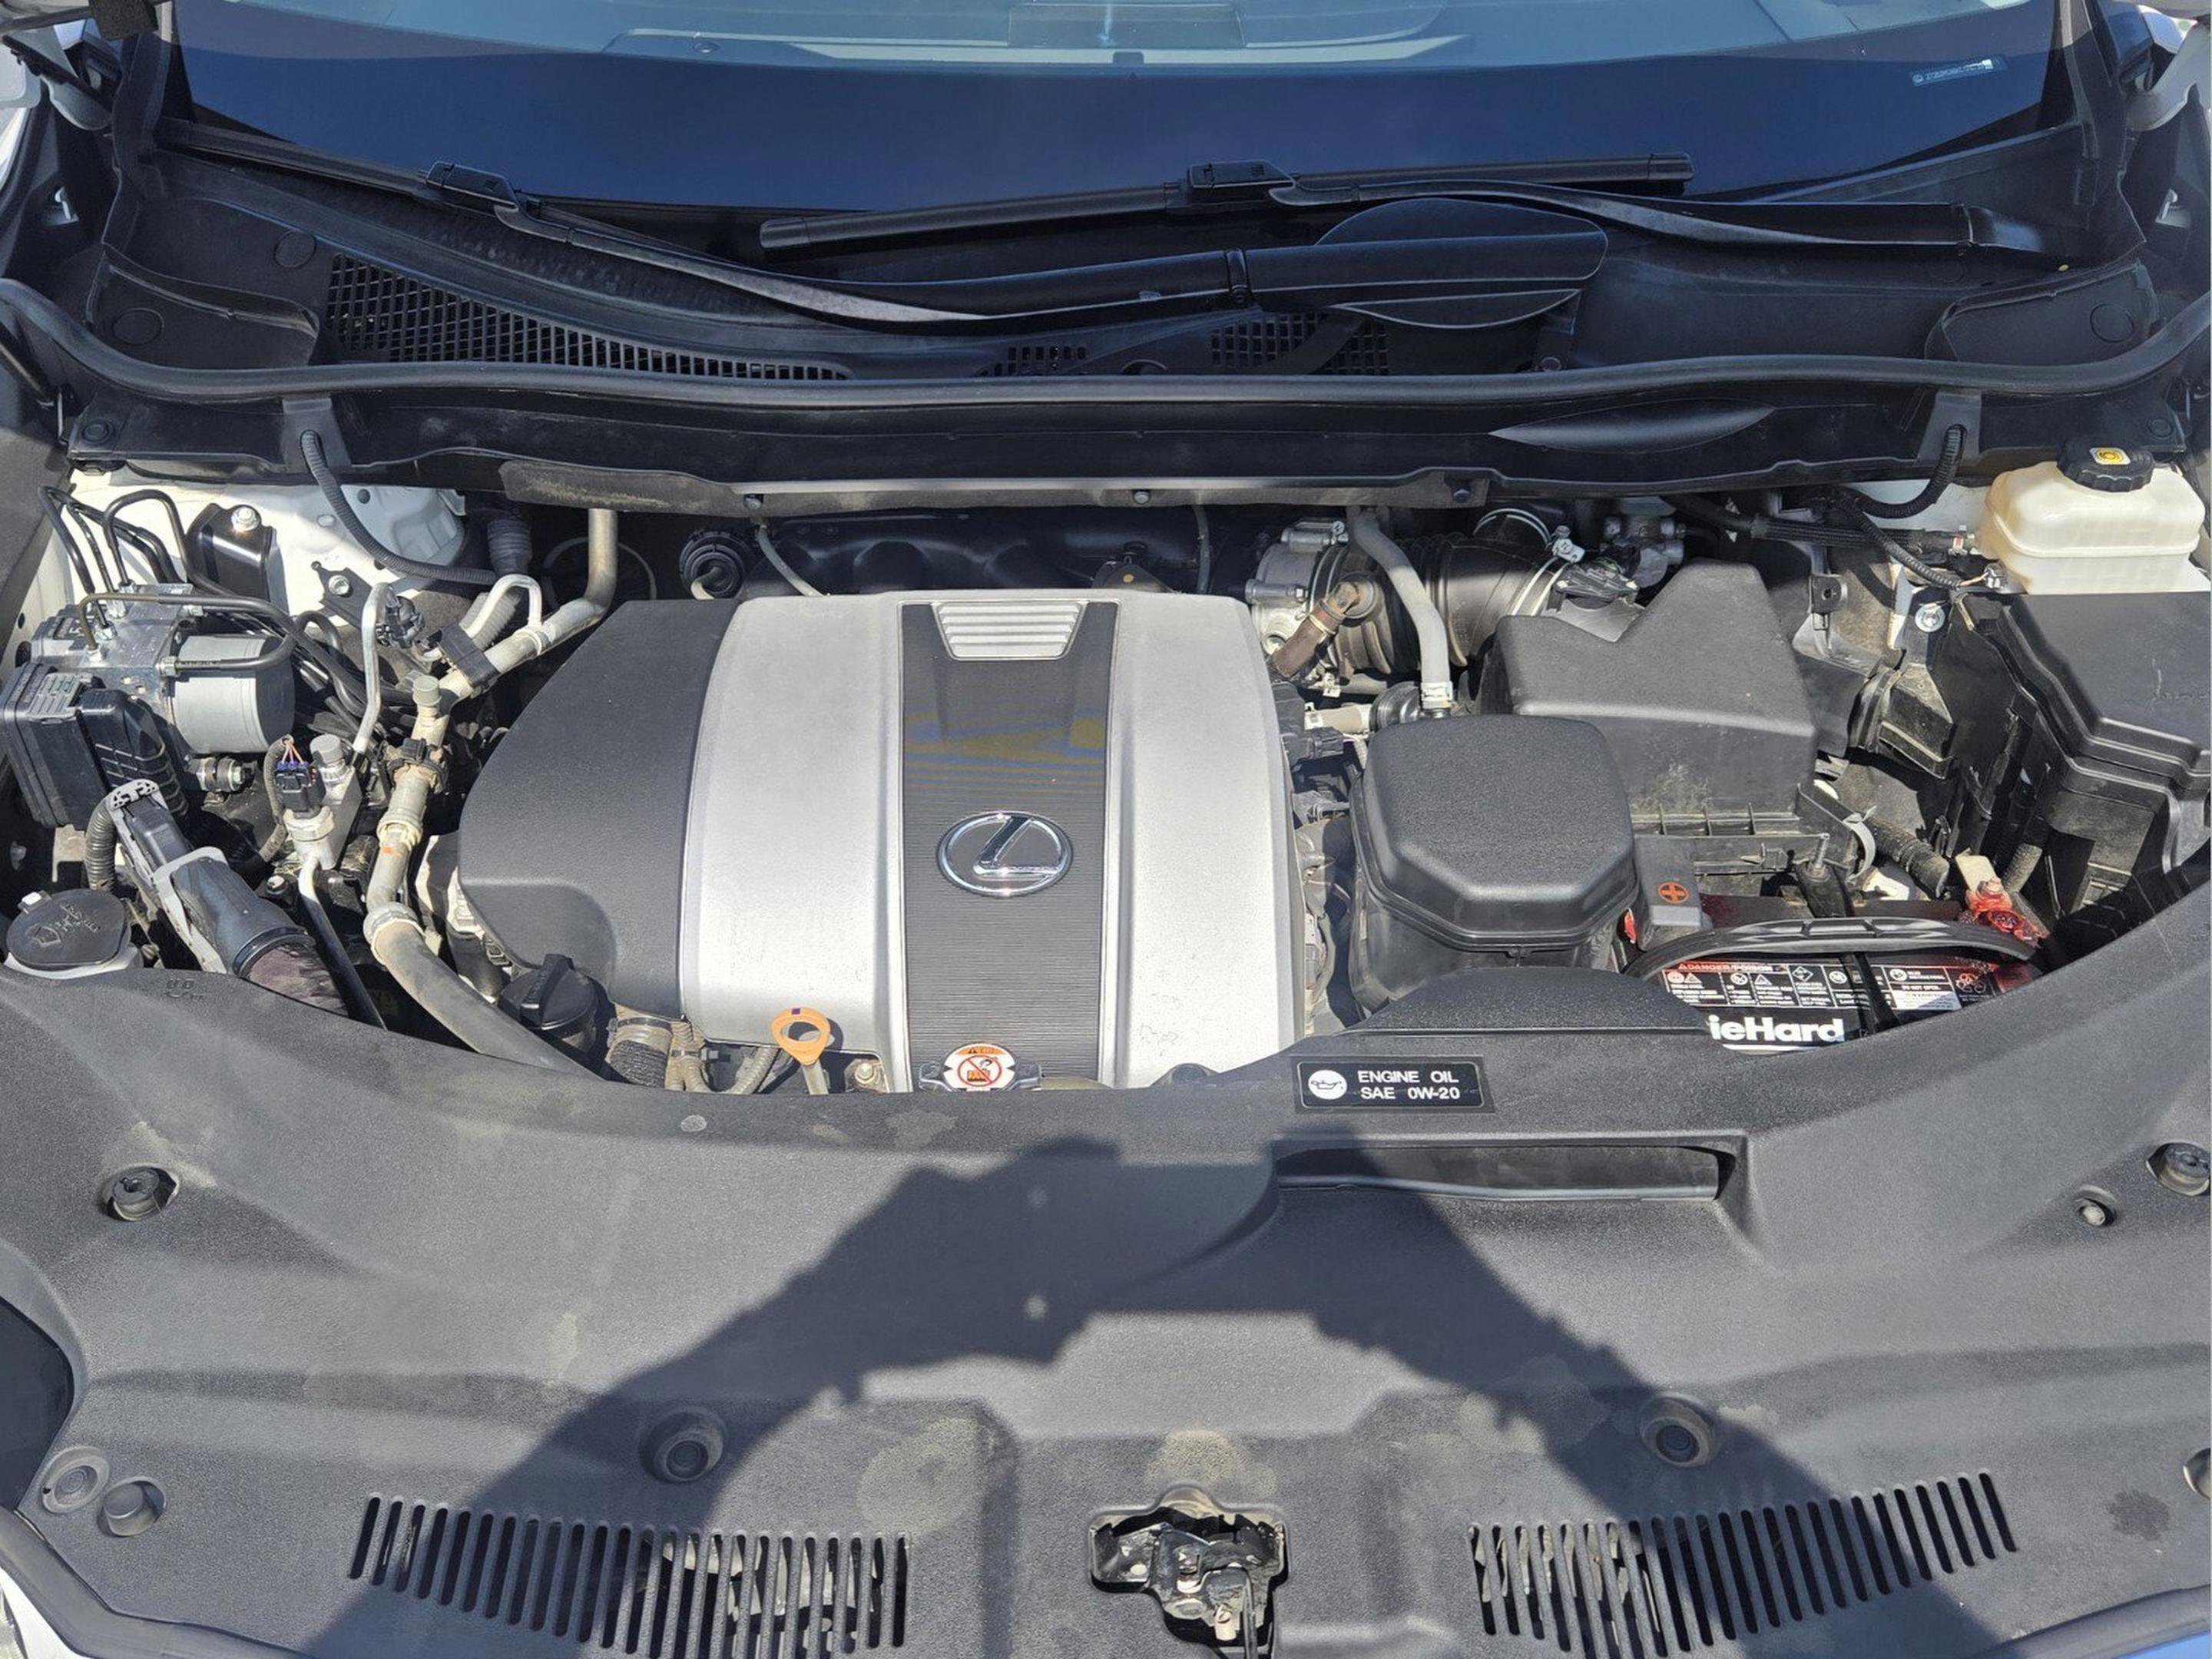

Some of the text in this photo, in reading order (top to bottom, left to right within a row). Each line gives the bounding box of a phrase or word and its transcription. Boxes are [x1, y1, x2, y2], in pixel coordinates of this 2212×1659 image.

[1706, 1013, 1844, 1042] ieHard
[1357, 1071, 1459, 1083] ENGINE OIL
[1361, 1087, 1460, 1100] SAE 0W-20
